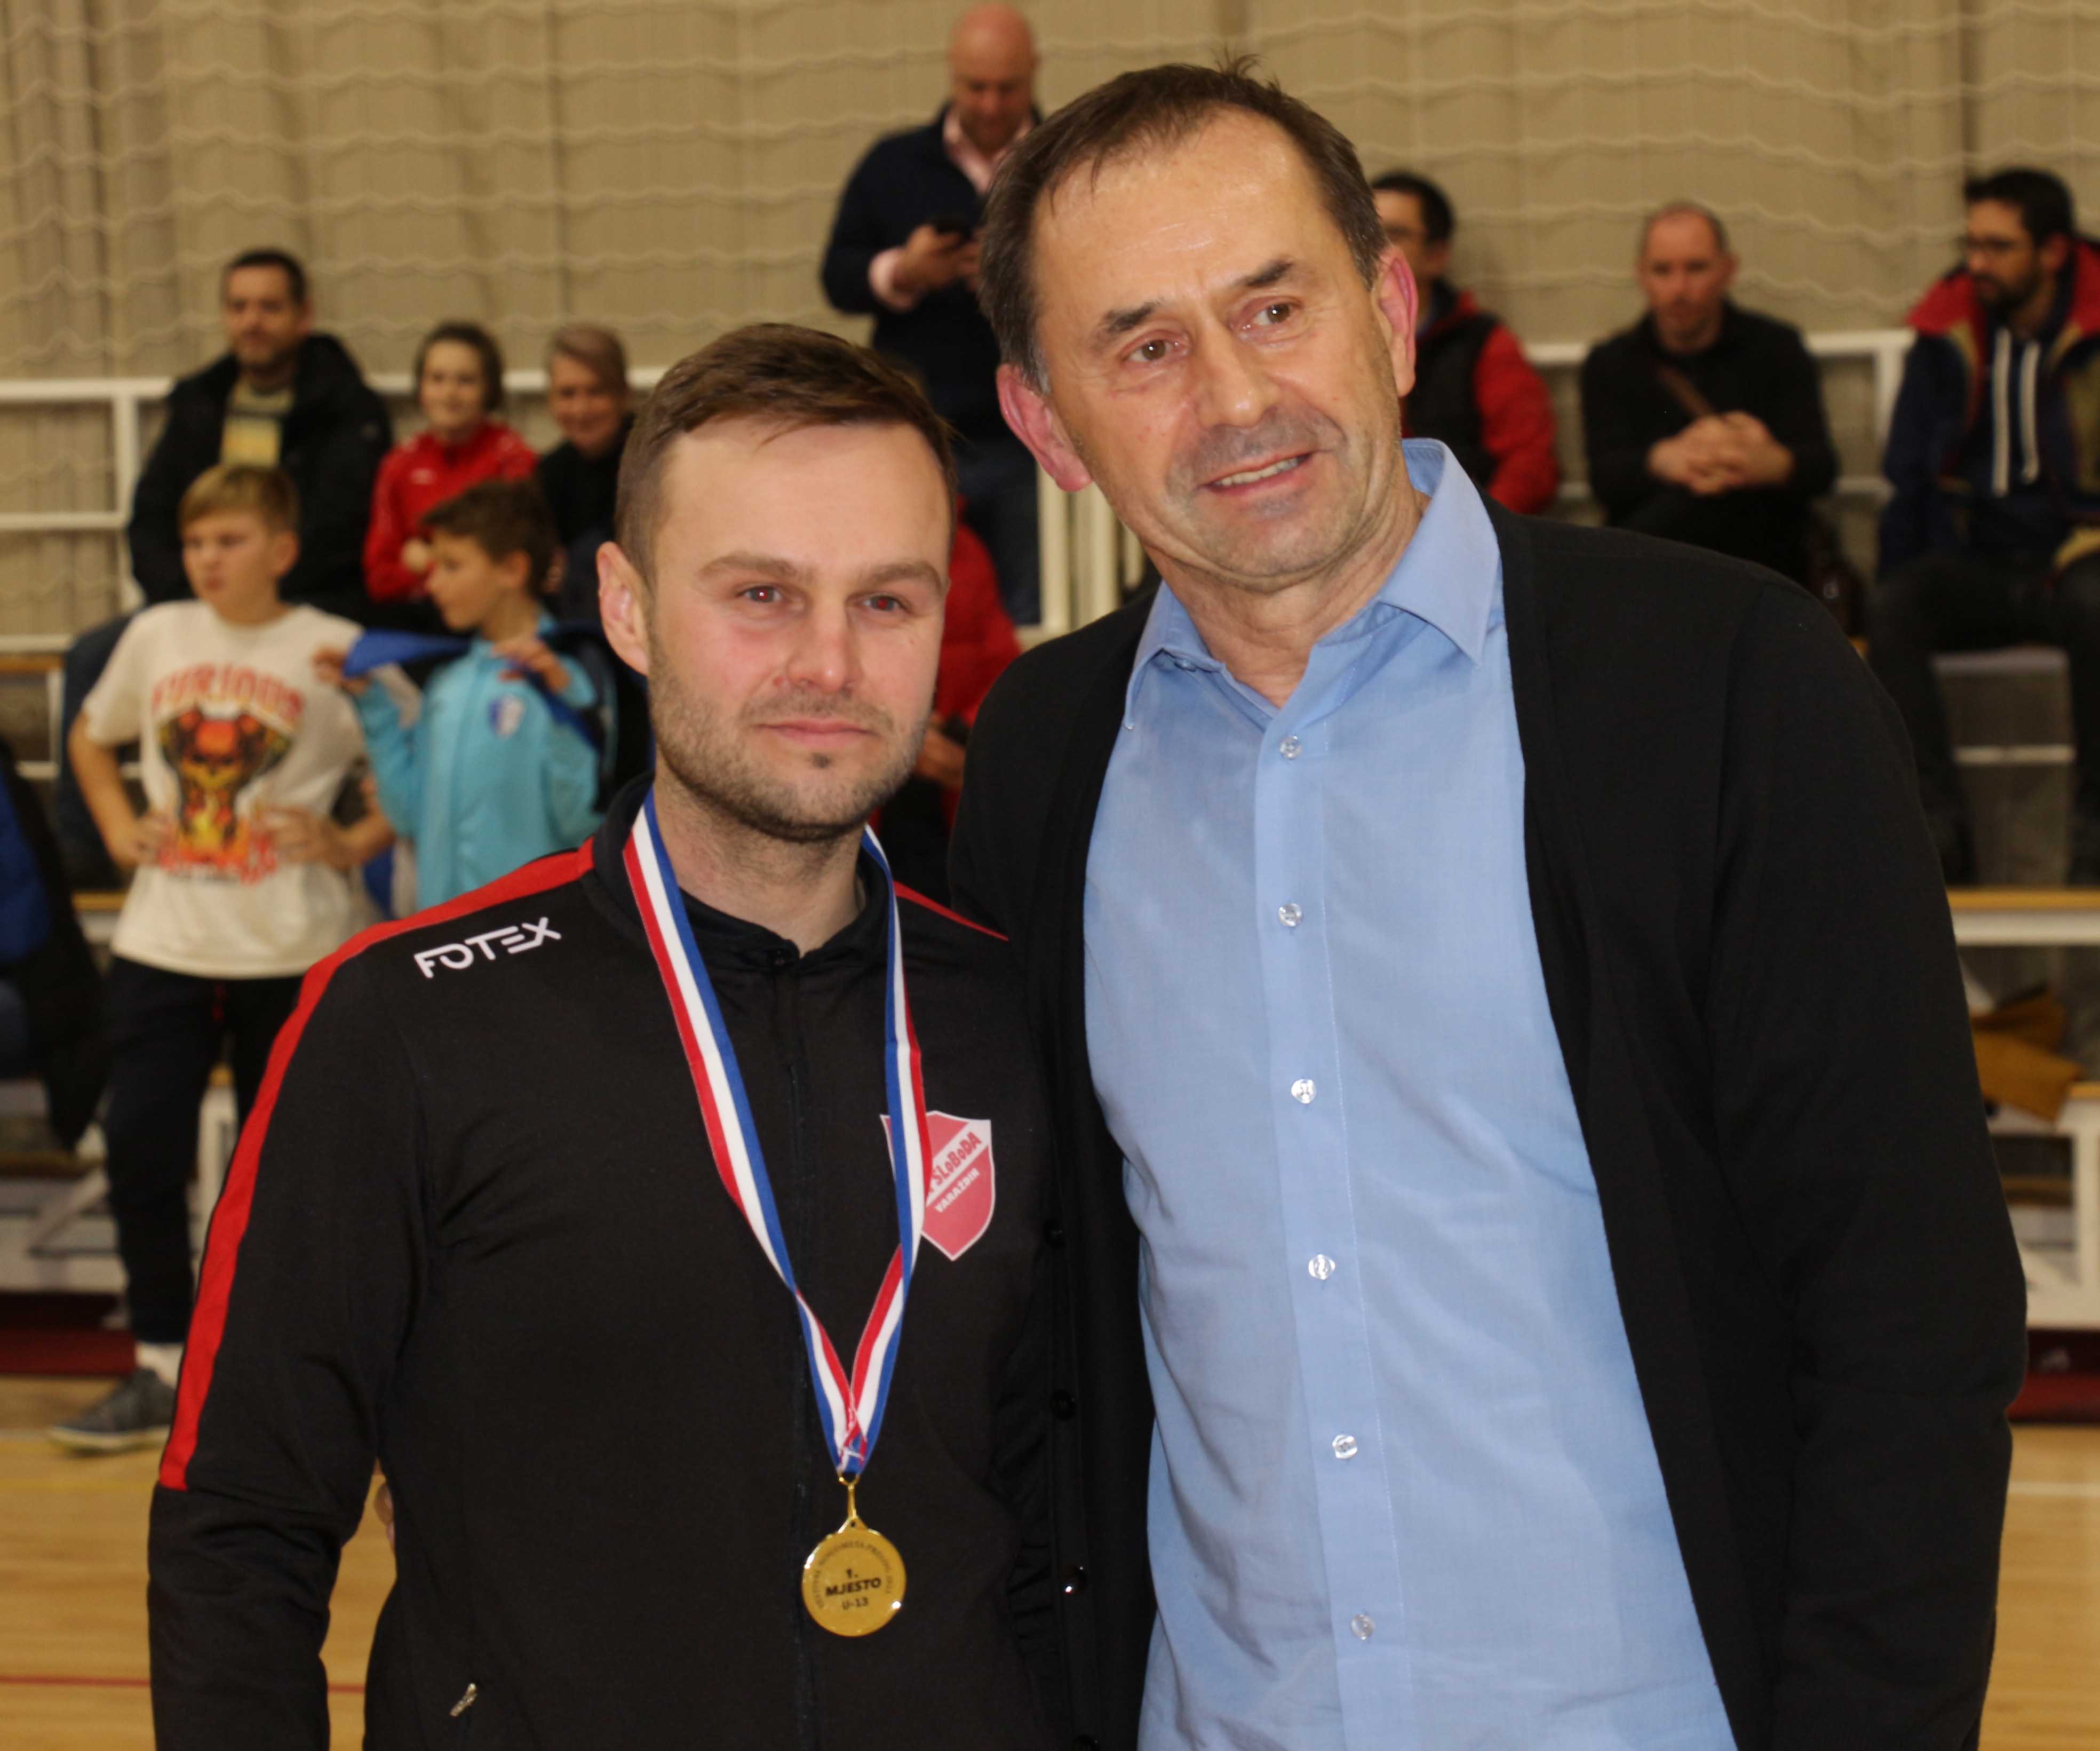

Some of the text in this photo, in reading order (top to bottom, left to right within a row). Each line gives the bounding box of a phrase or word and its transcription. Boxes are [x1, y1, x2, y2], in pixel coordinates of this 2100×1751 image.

[413, 916, 561, 978] FOTEX
[846, 1568, 859, 1579] 1.
[825, 1577, 882, 1597] MJESTO
[841, 1597, 869, 1611] U-13
